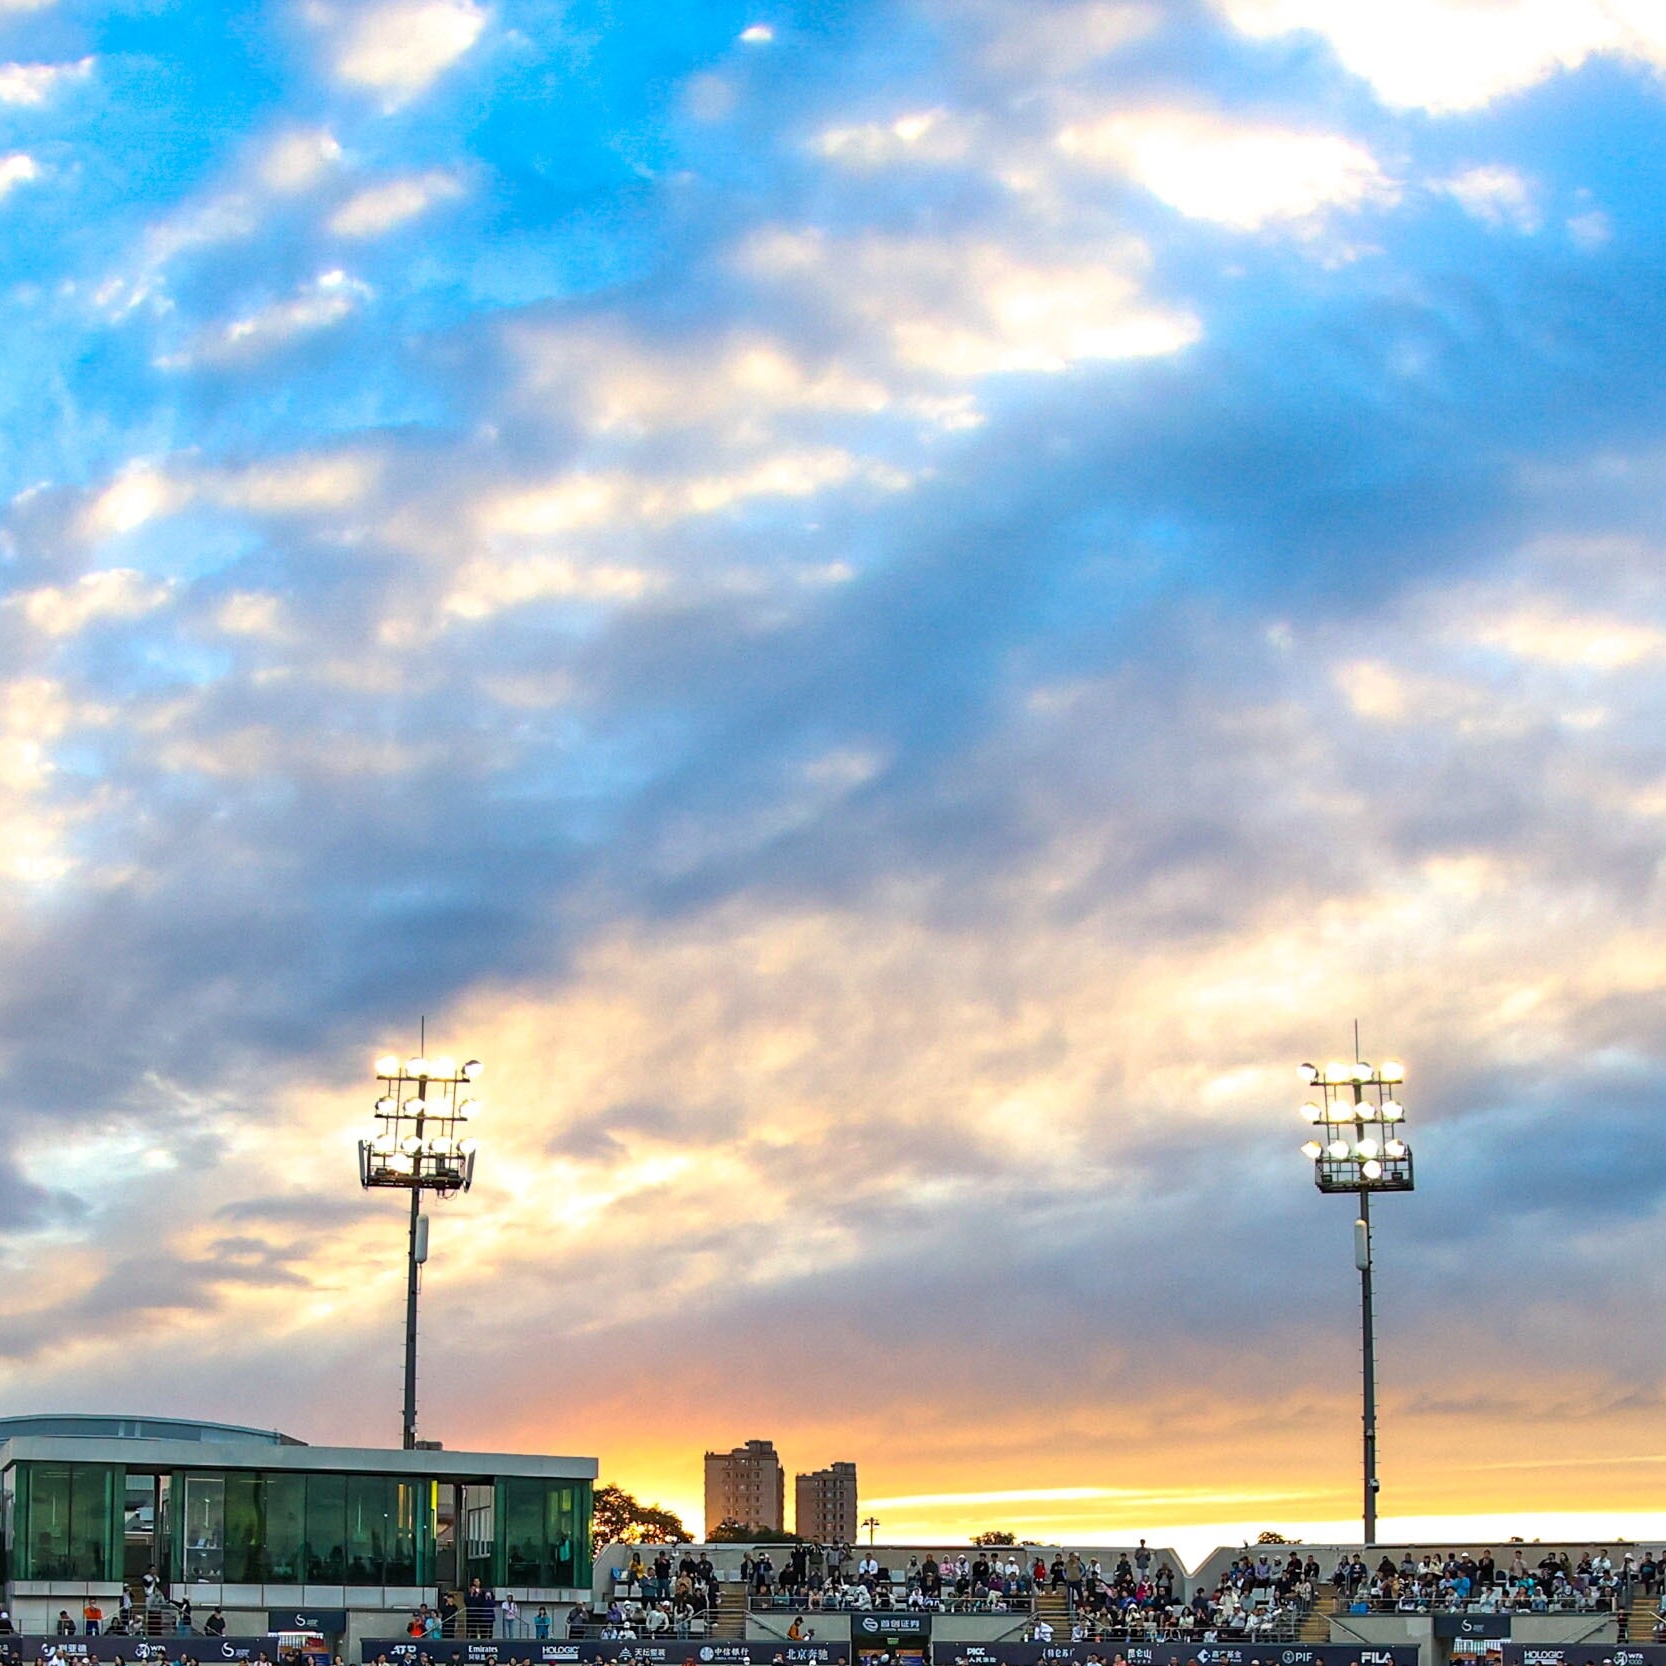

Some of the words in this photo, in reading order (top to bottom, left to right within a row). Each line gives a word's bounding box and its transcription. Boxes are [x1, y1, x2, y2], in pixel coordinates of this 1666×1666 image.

[468, 1645, 498, 1653] Emirates
[714, 1647, 749, 1657] 中信银行
[967, 1648, 985, 1656] PICC
[786, 1648, 828, 1661] 北京奔驰
[1296, 1651, 1313, 1662] PIF
[1361, 1652, 1391, 1664] FILA
[1524, 1651, 1564, 1659] HOLOGIC
